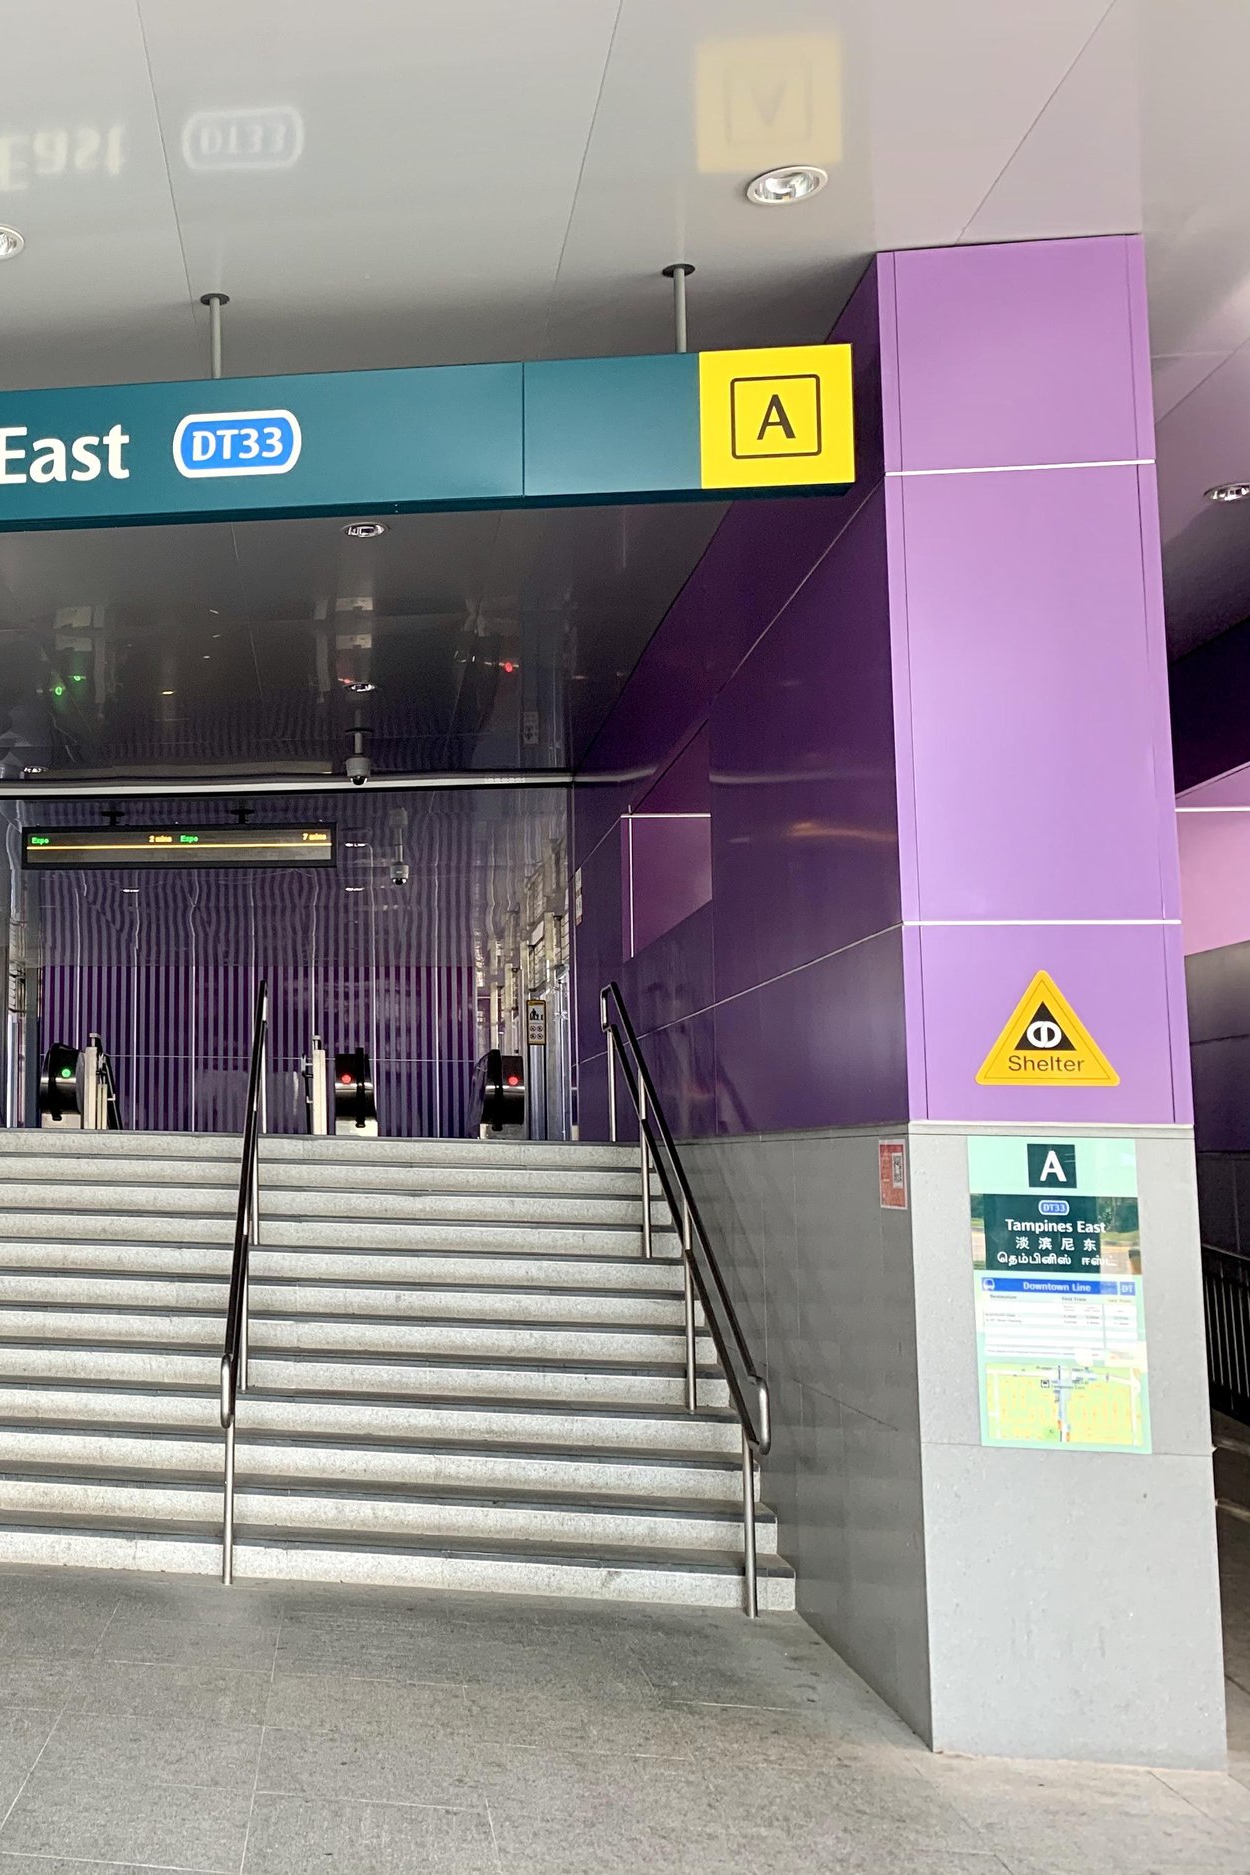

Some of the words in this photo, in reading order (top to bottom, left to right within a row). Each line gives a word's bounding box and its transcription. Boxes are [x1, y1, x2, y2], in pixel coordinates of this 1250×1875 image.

[756, 394, 797, 441] A
[192, 426, 284, 462] DT33
[148, 835, 155, 843] 2
[1008, 1055, 1084, 1072] Shelter
[1039, 1150, 1067, 1182] A
[1042, 1203, 1066, 1213] DT33
[1005, 1219, 1073, 1234] Tampines
[1077, 1221, 1107, 1234] East
[1015, 1236, 1097, 1252] 淡滨尼东
[1023, 1281, 1069, 1292] Downtown
[1072, 1282, 1091, 1293] Line
[1121, 1284, 1134, 1294] DT
